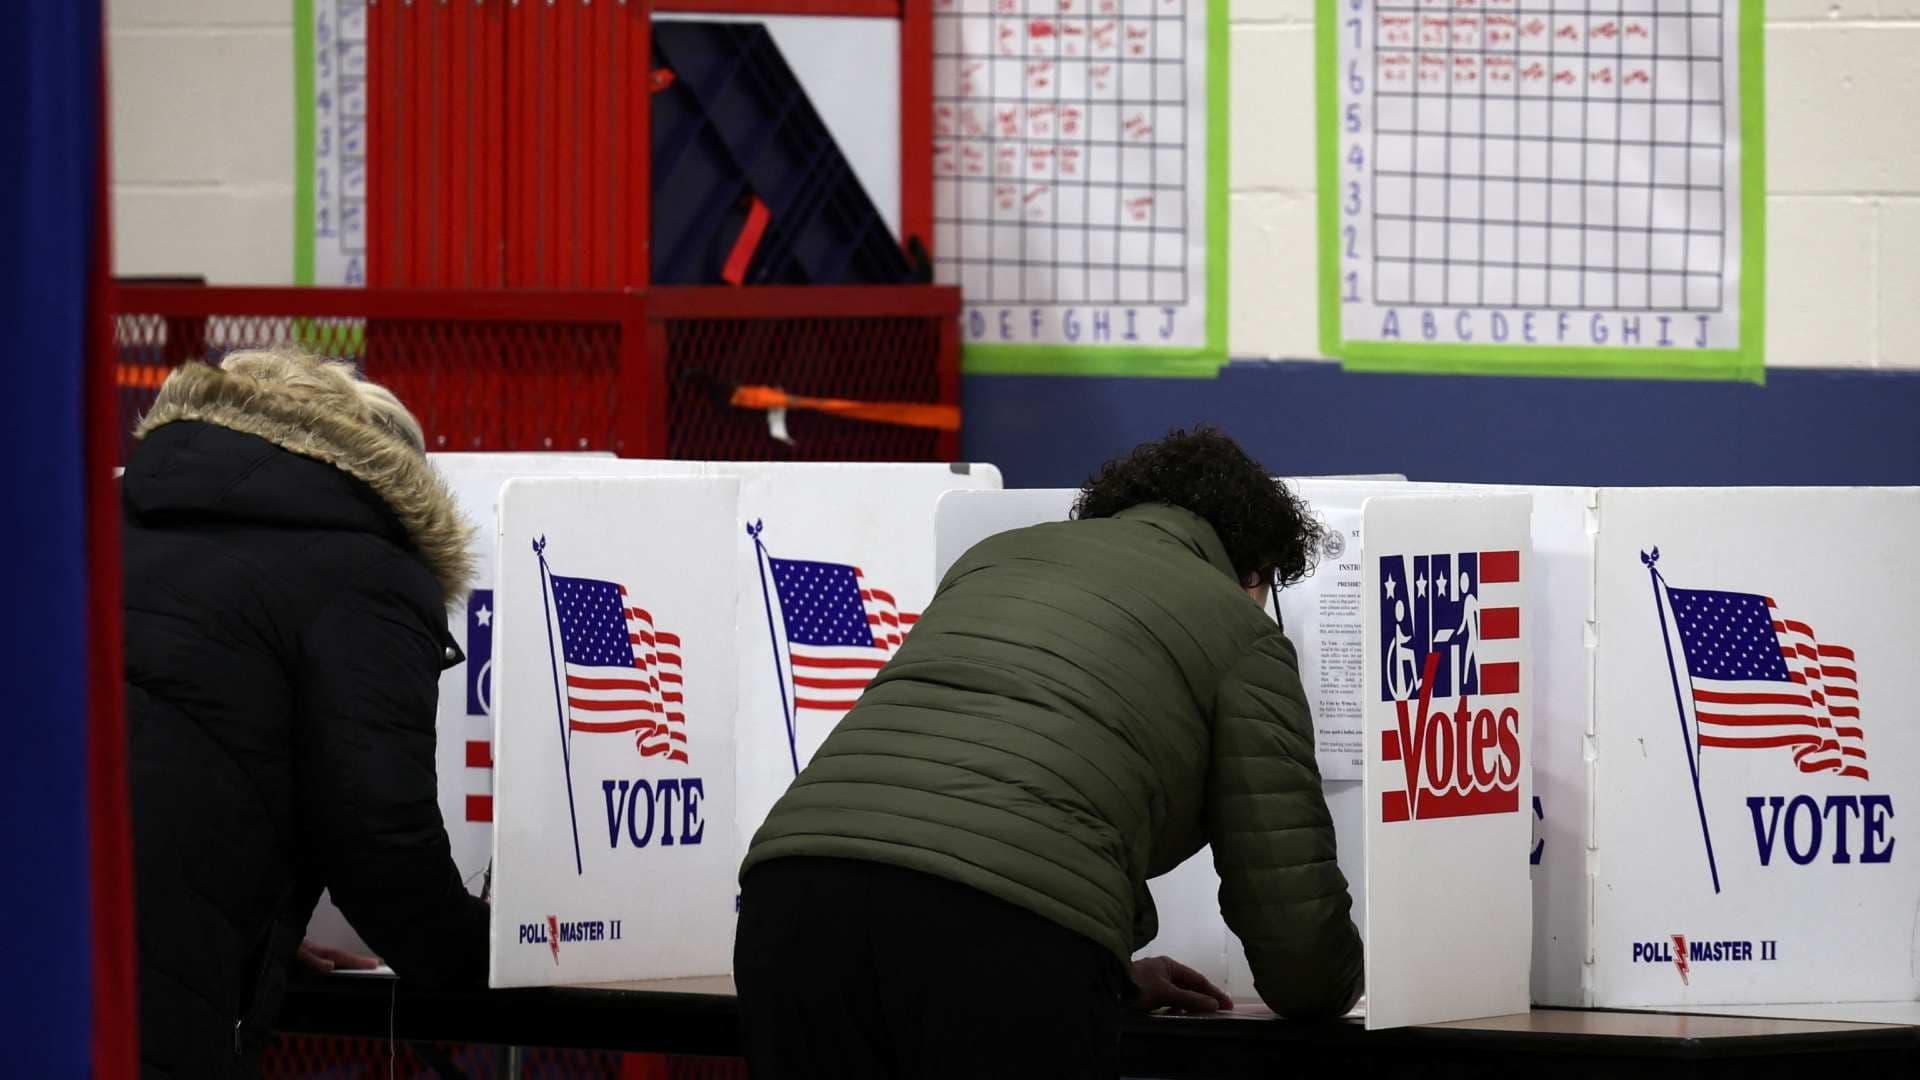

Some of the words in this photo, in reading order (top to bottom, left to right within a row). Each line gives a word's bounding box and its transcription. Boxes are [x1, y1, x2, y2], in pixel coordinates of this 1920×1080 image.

[1347, 59, 1364, 94] 6
[1346, 103, 1361, 133] 5
[1348, 144, 1364, 172] 4
[1345, 181, 1362, 216] 3
[1343, 225, 1360, 258] 2
[1343, 271, 1362, 303] 1
[969, 309, 986, 339] D
[999, 309, 1013, 340] E
[1031, 309, 1044, 340] F
[1063, 309, 1081, 341] G
[1093, 310, 1111, 341] H
[1123, 309, 1139, 341] I
[1160, 308, 1177, 340] J
[1381, 309, 1400, 339] A
[1421, 310, 1438, 341] B
[1455, 312, 1473, 341] C
[1491, 314, 1508, 342] D
[1522, 313, 1537, 342] E
[1557, 314, 1571, 342] F
[1590, 313, 1608, 343] G
[1622, 316, 1640, 345] H
[1656, 316, 1674, 346] I
[1695, 315, 1711, 347] J
[1396, 652, 1520, 820] Votes
[602, 777, 704, 848] VOTE
[1746, 794, 1895, 866] VOTE
[519, 923, 547, 944] POLL
[559, 921, 604, 942] MASTER
[609, 920, 622, 940] II
[1633, 941, 1672, 962] POLL
[1690, 941, 1752, 961] MASTER
[1761, 940, 1777, 961] II
